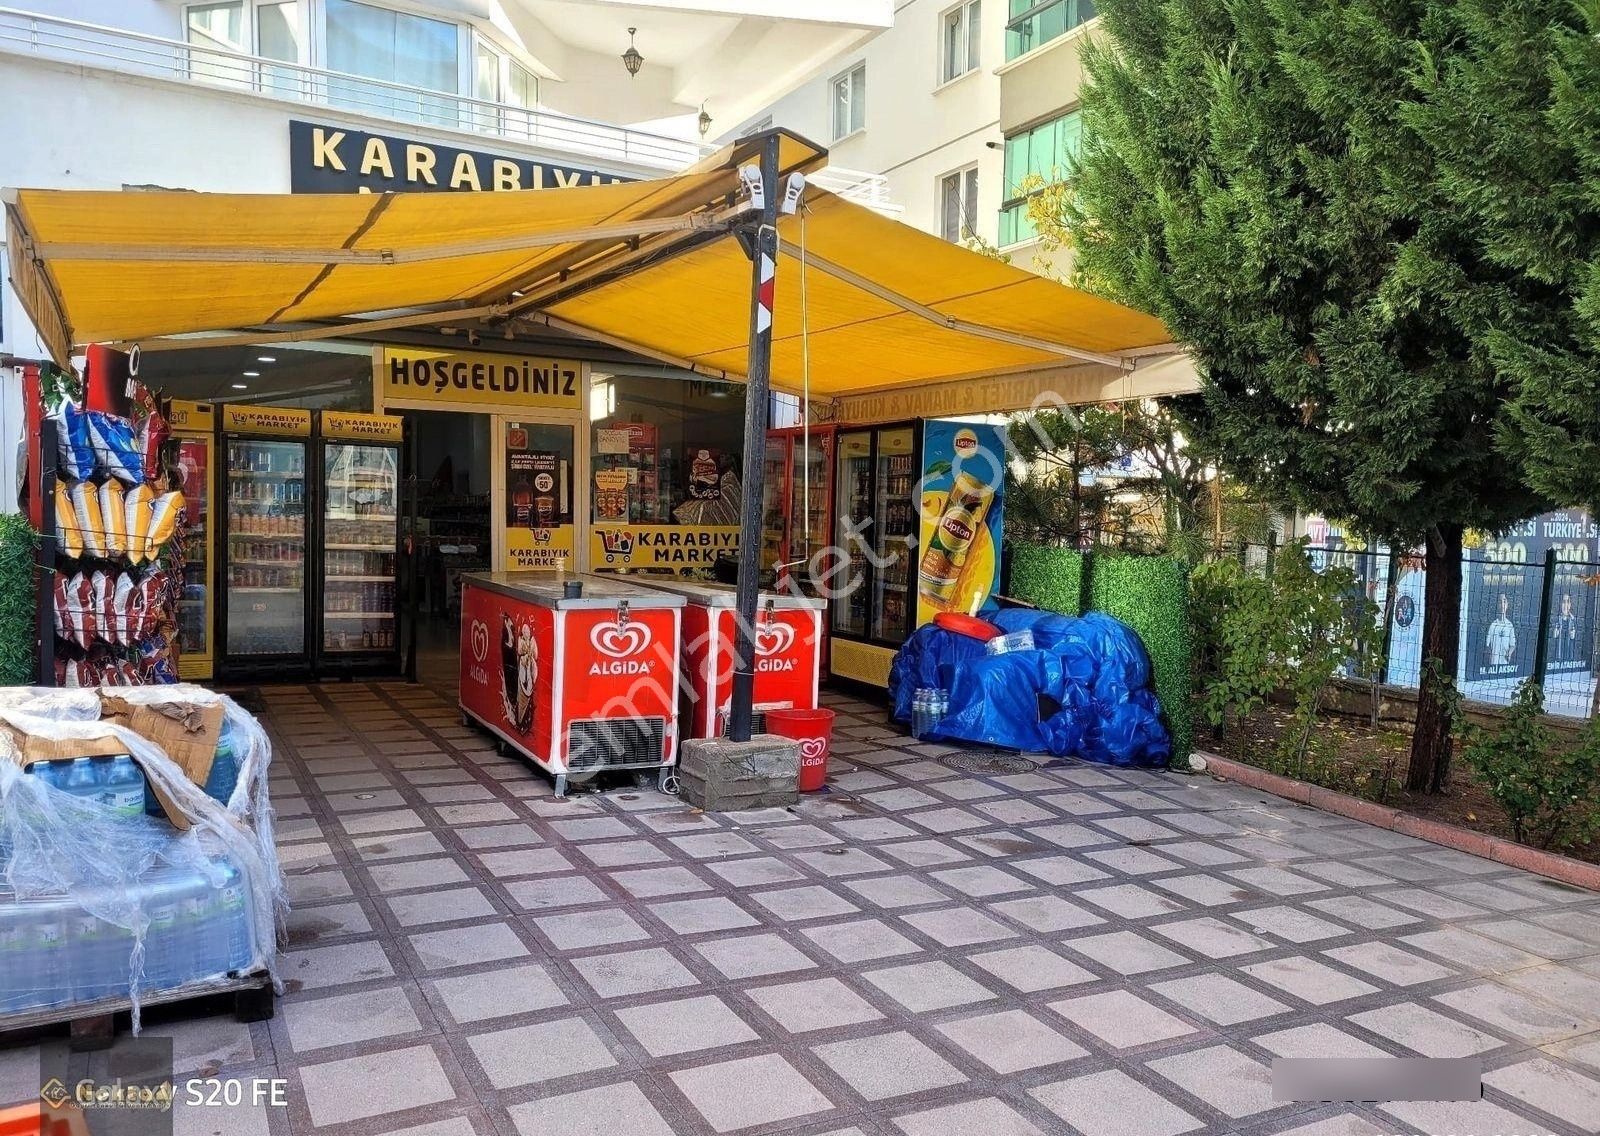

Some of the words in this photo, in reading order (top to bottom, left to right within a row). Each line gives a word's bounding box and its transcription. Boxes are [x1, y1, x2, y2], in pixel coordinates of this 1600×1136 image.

[391, 357, 576, 396] HOŞGELDİNİZ
[249, 413, 307, 423] KARABIYIK
[256, 420, 300, 429] MARKET
[345, 419, 399, 429] KARABIYIK
[352, 426, 391, 434] MARKET
[957, 439, 975, 449] Lipton
[945, 518, 971, 541] Lipton
[510, 549, 570, 557] KARABIYIK
[518, 558, 555, 566] MARKE
